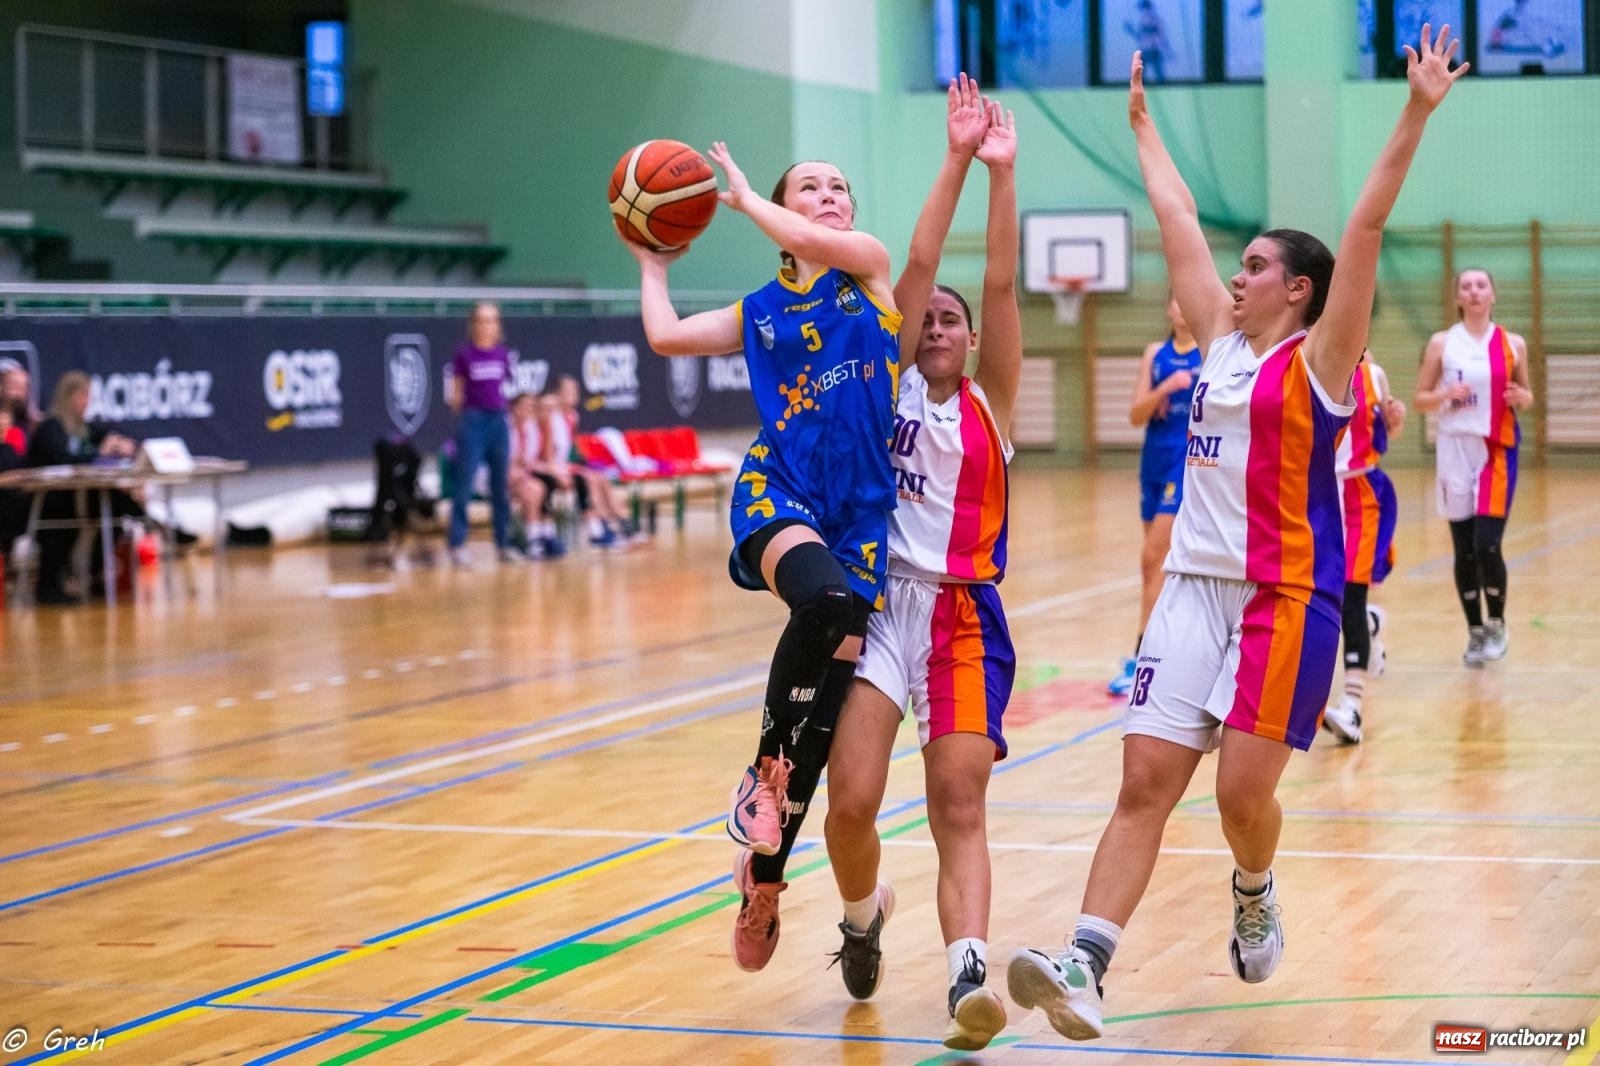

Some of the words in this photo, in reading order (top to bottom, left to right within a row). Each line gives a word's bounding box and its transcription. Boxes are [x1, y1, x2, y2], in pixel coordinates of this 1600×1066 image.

[800, 321, 823, 352] 5
[83, 357, 214, 423] ACIBÓRZ
[798, 687, 816, 702] NBA
